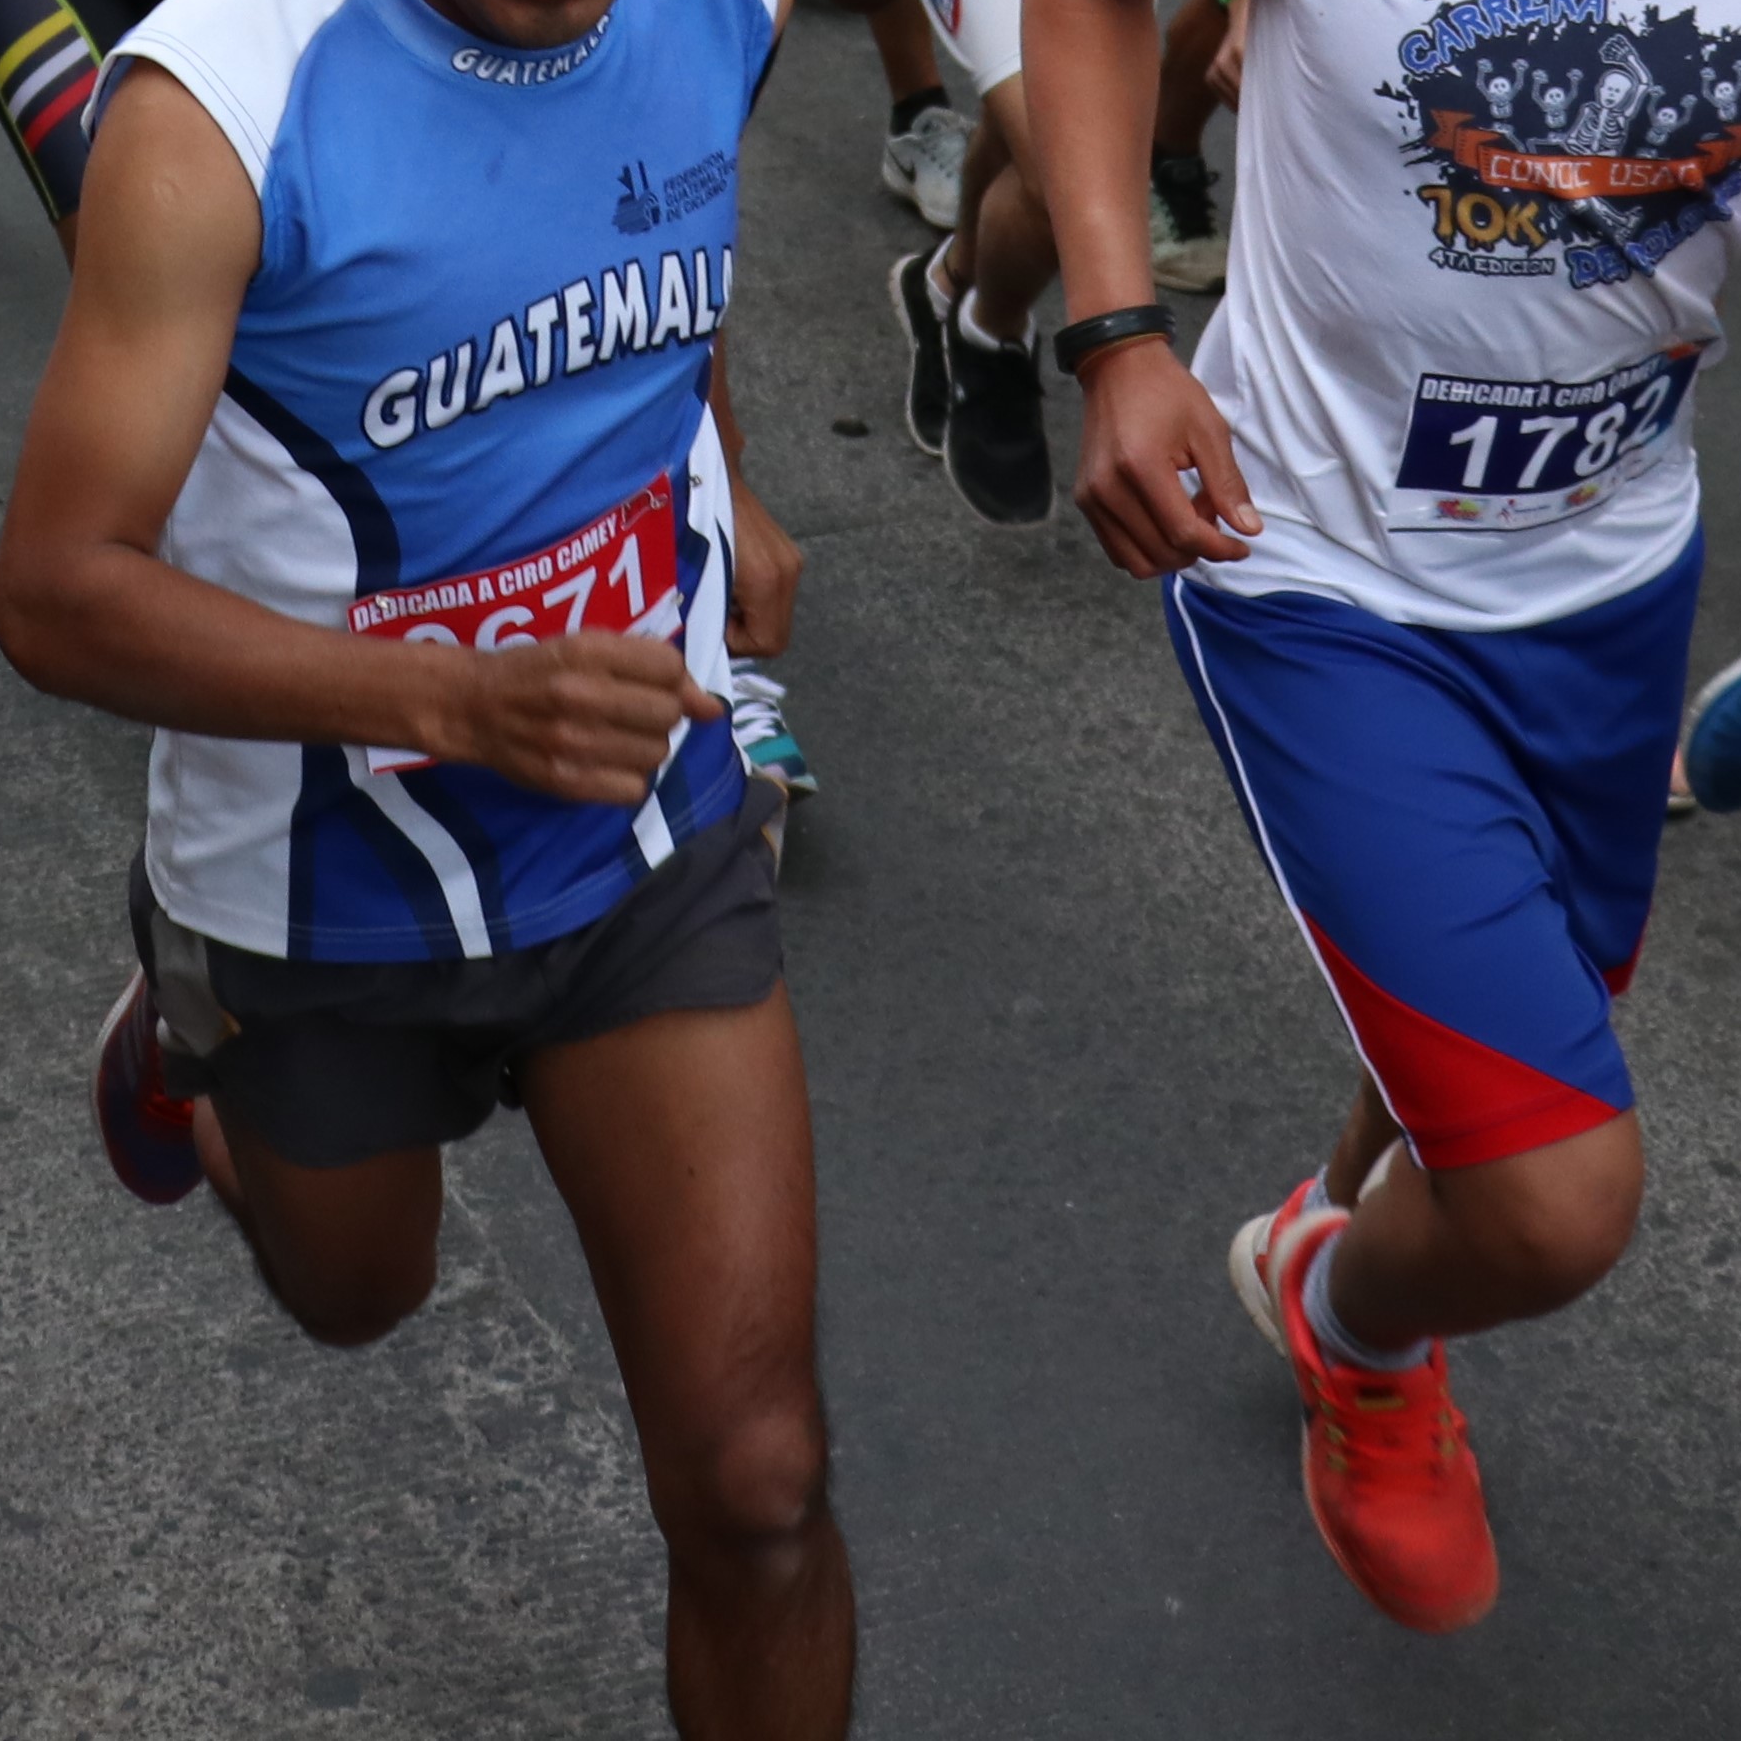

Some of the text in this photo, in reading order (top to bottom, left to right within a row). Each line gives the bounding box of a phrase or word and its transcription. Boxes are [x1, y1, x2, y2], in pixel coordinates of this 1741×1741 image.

[451, 13, 611, 86] GUATEMALA
[1419, 187, 1549, 255] 10K
[1430, 248, 1474, 273] 4TA
[1566, 245, 1630, 289] DE
[1420, 377, 1535, 408] DEDICADA
[1554, 380, 1606, 408] CIRO
[1449, 374, 1671, 489] 1782
[352, 512, 619, 632] DEDICADA A CIRO CAMEY
